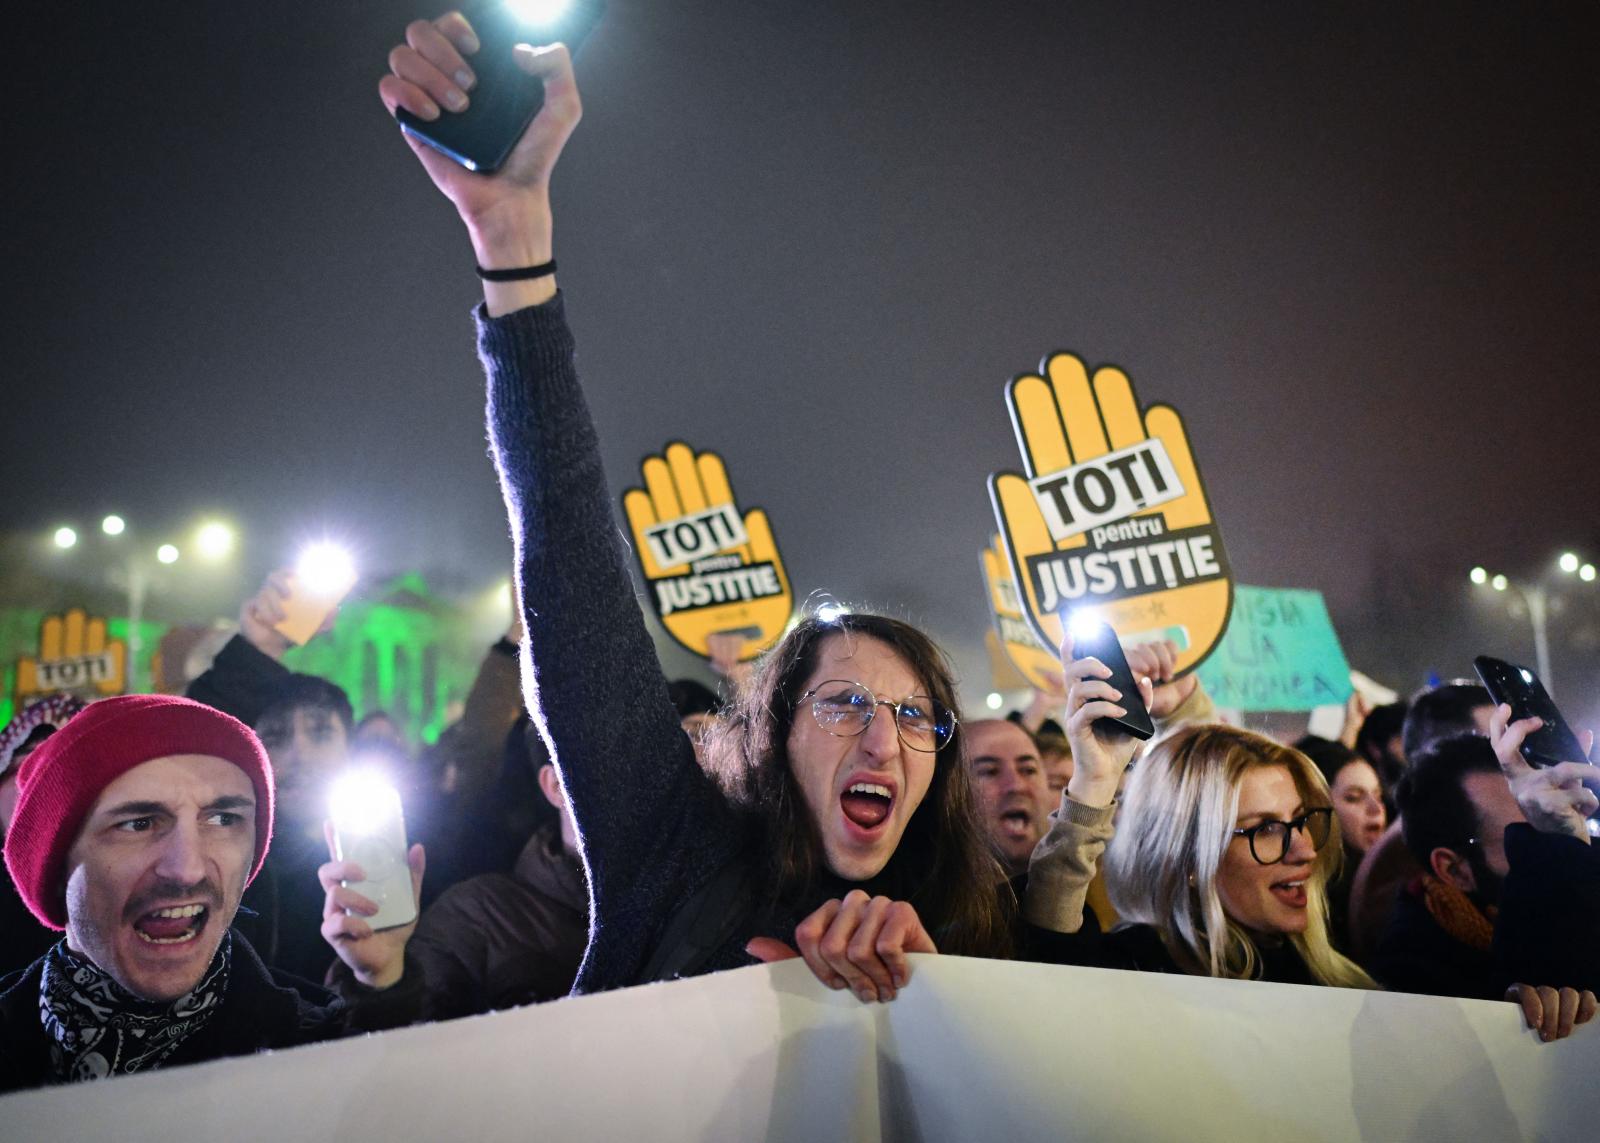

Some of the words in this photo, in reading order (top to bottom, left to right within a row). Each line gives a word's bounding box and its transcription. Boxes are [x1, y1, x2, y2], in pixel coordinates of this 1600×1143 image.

[1036, 449, 1168, 525] TOȚI
[1092, 517, 1163, 549] pentru
[1036, 535, 1221, 611] JUSTIȚIE
